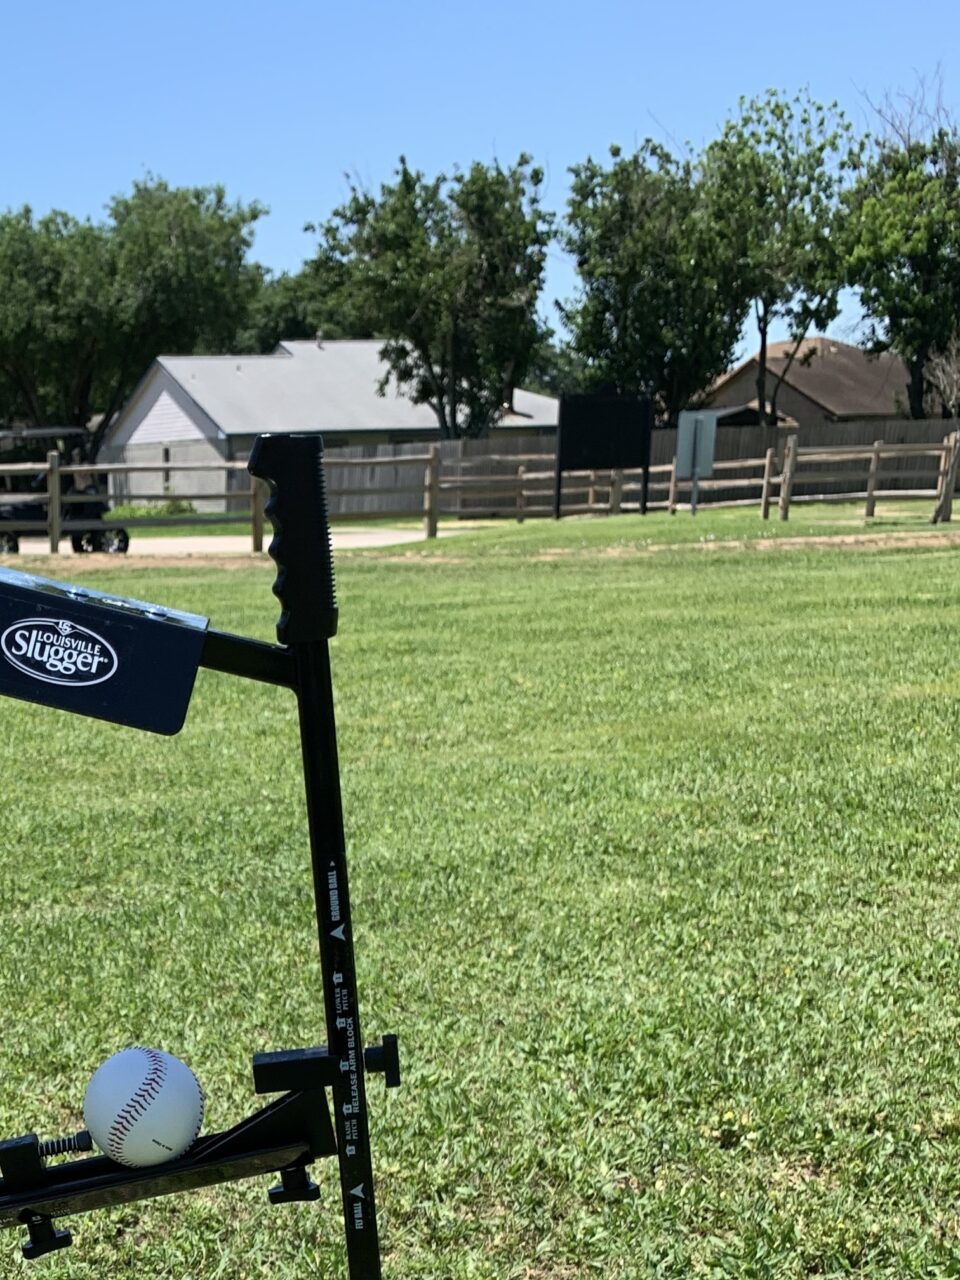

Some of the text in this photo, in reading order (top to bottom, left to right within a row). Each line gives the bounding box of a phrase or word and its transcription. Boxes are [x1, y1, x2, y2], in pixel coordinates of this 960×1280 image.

[11, 630, 104, 674] Slugger
[37, 630, 102, 655] LOUISVILLE
[328, 870, 340, 921] GROUND BALL
[346, 1017, 360, 1113] RELEASE ARM BLOCK
